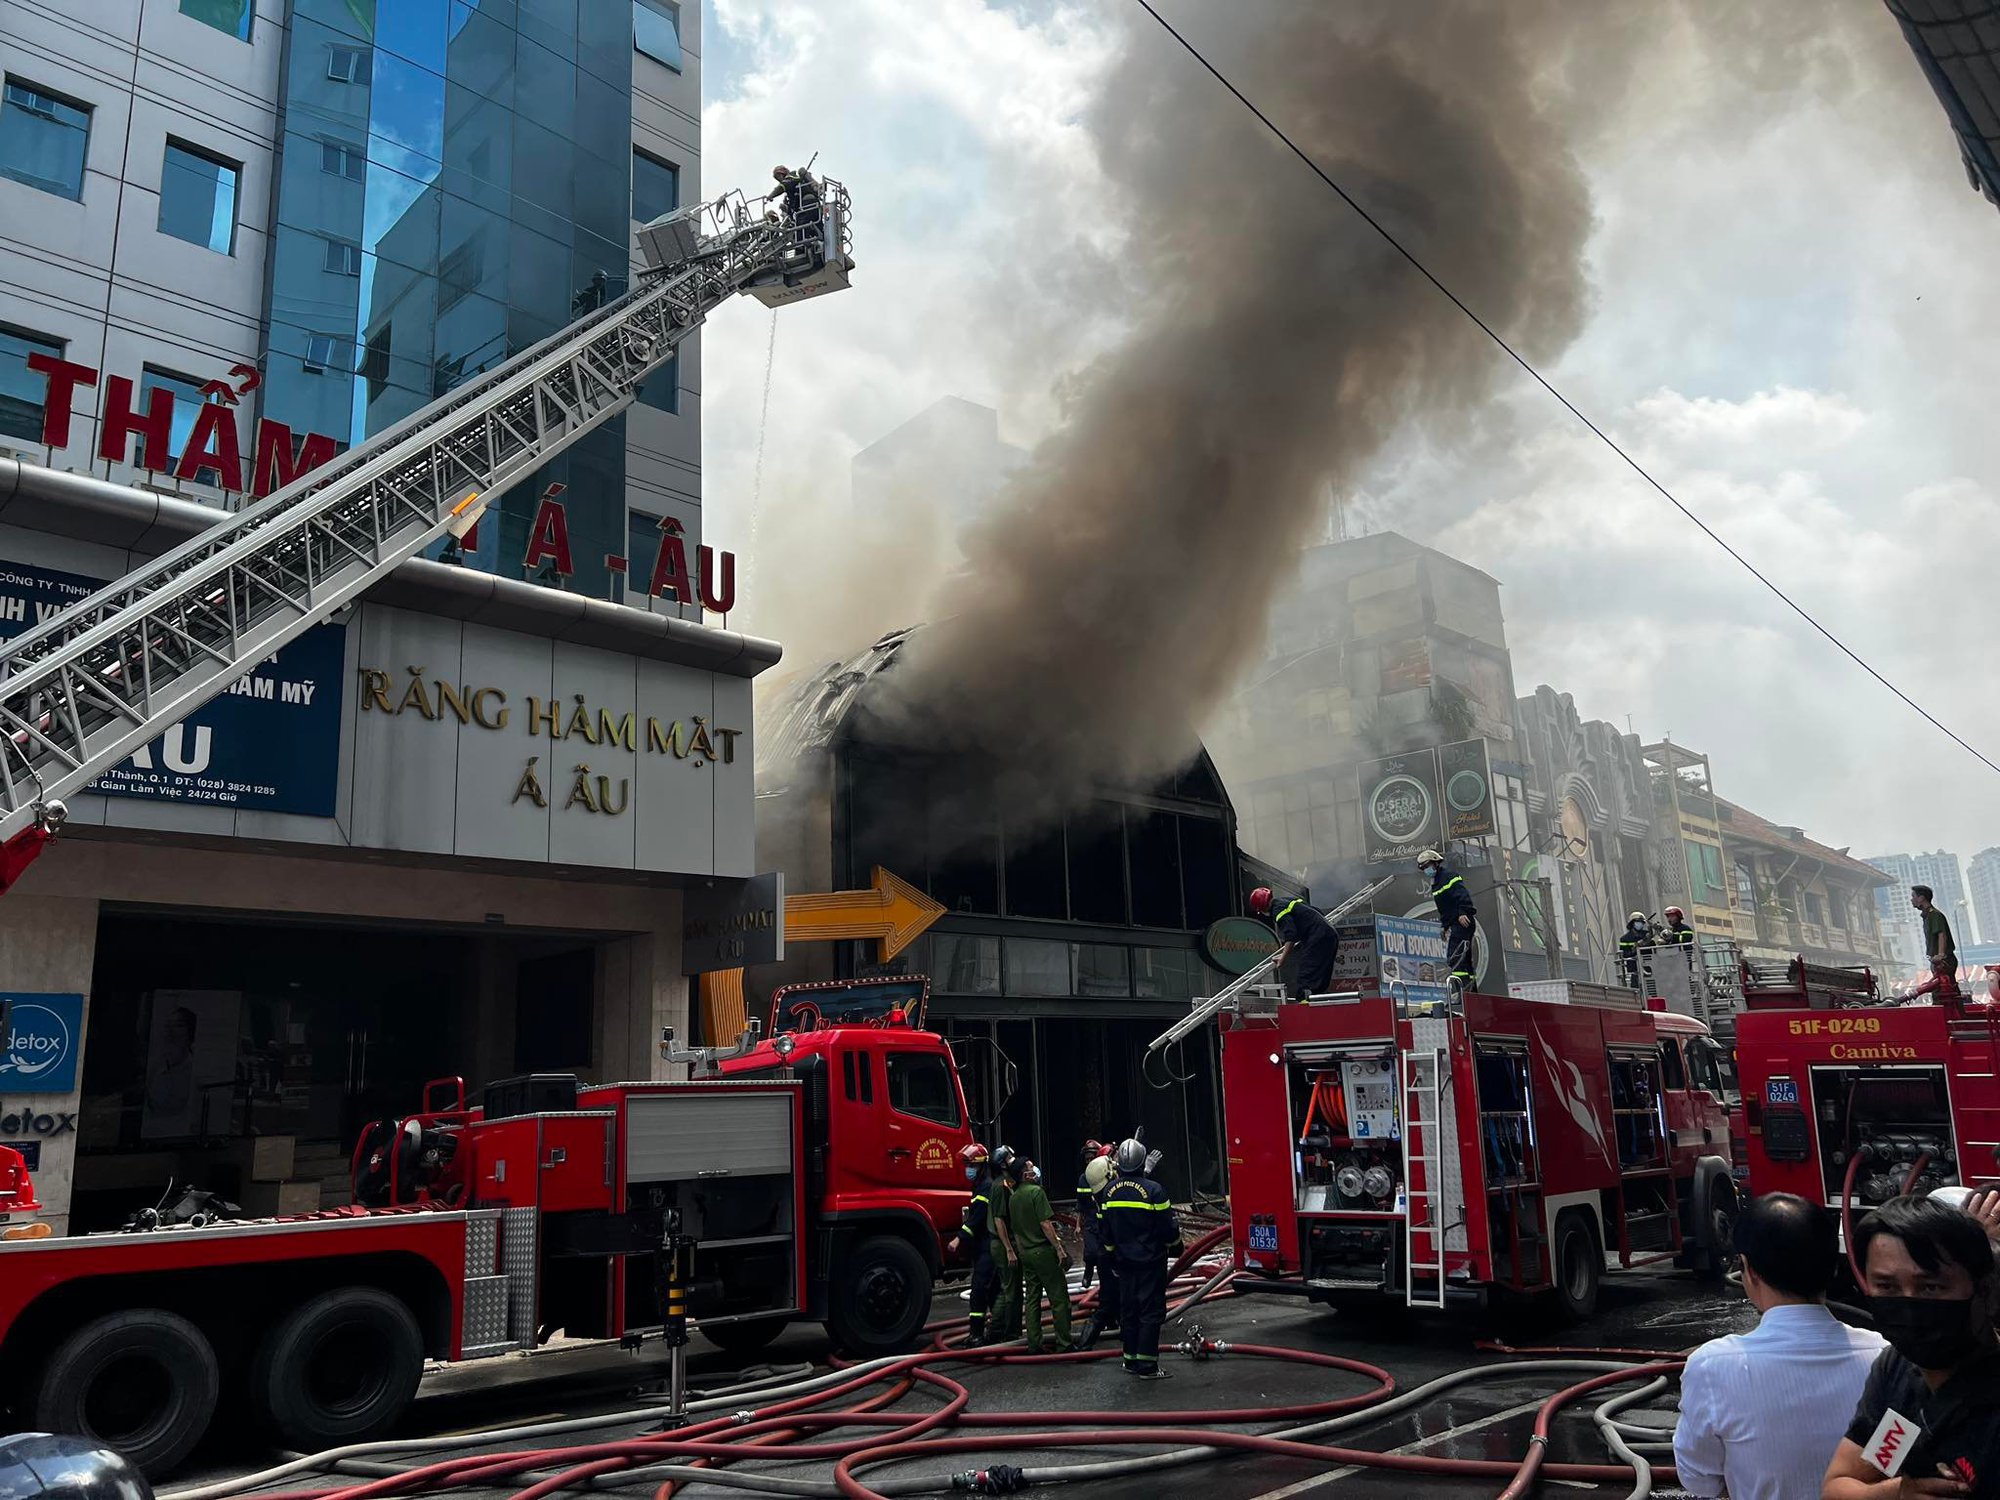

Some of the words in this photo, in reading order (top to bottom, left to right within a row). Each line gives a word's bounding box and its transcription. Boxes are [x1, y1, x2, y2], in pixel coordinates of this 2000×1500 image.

[27, 352, 336, 498] THẨM
[37, 579, 54, 590] TY
[58, 583, 91, 597] TNHH
[281, 680, 316, 705] MỸ
[359, 665, 509, 730] RĂNG
[528, 694, 636, 752] HÀM
[647, 715, 743, 768] MẶT
[101, 781, 126, 791] Gian
[159, 785, 183, 798] Việc
[187, 789, 217, 801] 24/24
[197, 777, 224, 790] (028)
[227, 782, 251, 793] 3824
[254, 785, 276, 796] 1285
[512, 756, 547, 808] Á
[565, 763, 629, 816] ÂU
[1457, 812, 1481, 825] Halal
[1451, 822, 1490, 836] Restaurant
[1563, 862, 1580, 956] CUISINE
[1381, 931, 1407, 954] TOUR
[1408, 935, 1448, 958] BOOKING
[1350, 955, 1370, 963] THAI
[1789, 1018, 1880, 1034] 51F-0249
[1830, 1043, 1917, 1059] Camiva
[1772, 1082, 1789, 1092] 51F
[1769, 1092, 1795, 1102] 0249
[928, 1148, 940, 1158] 114
[1255, 1226, 1270, 1237] 50A
[1250, 1236, 1276, 1247] 01532
[1875, 1419, 1905, 1469] ANTV
